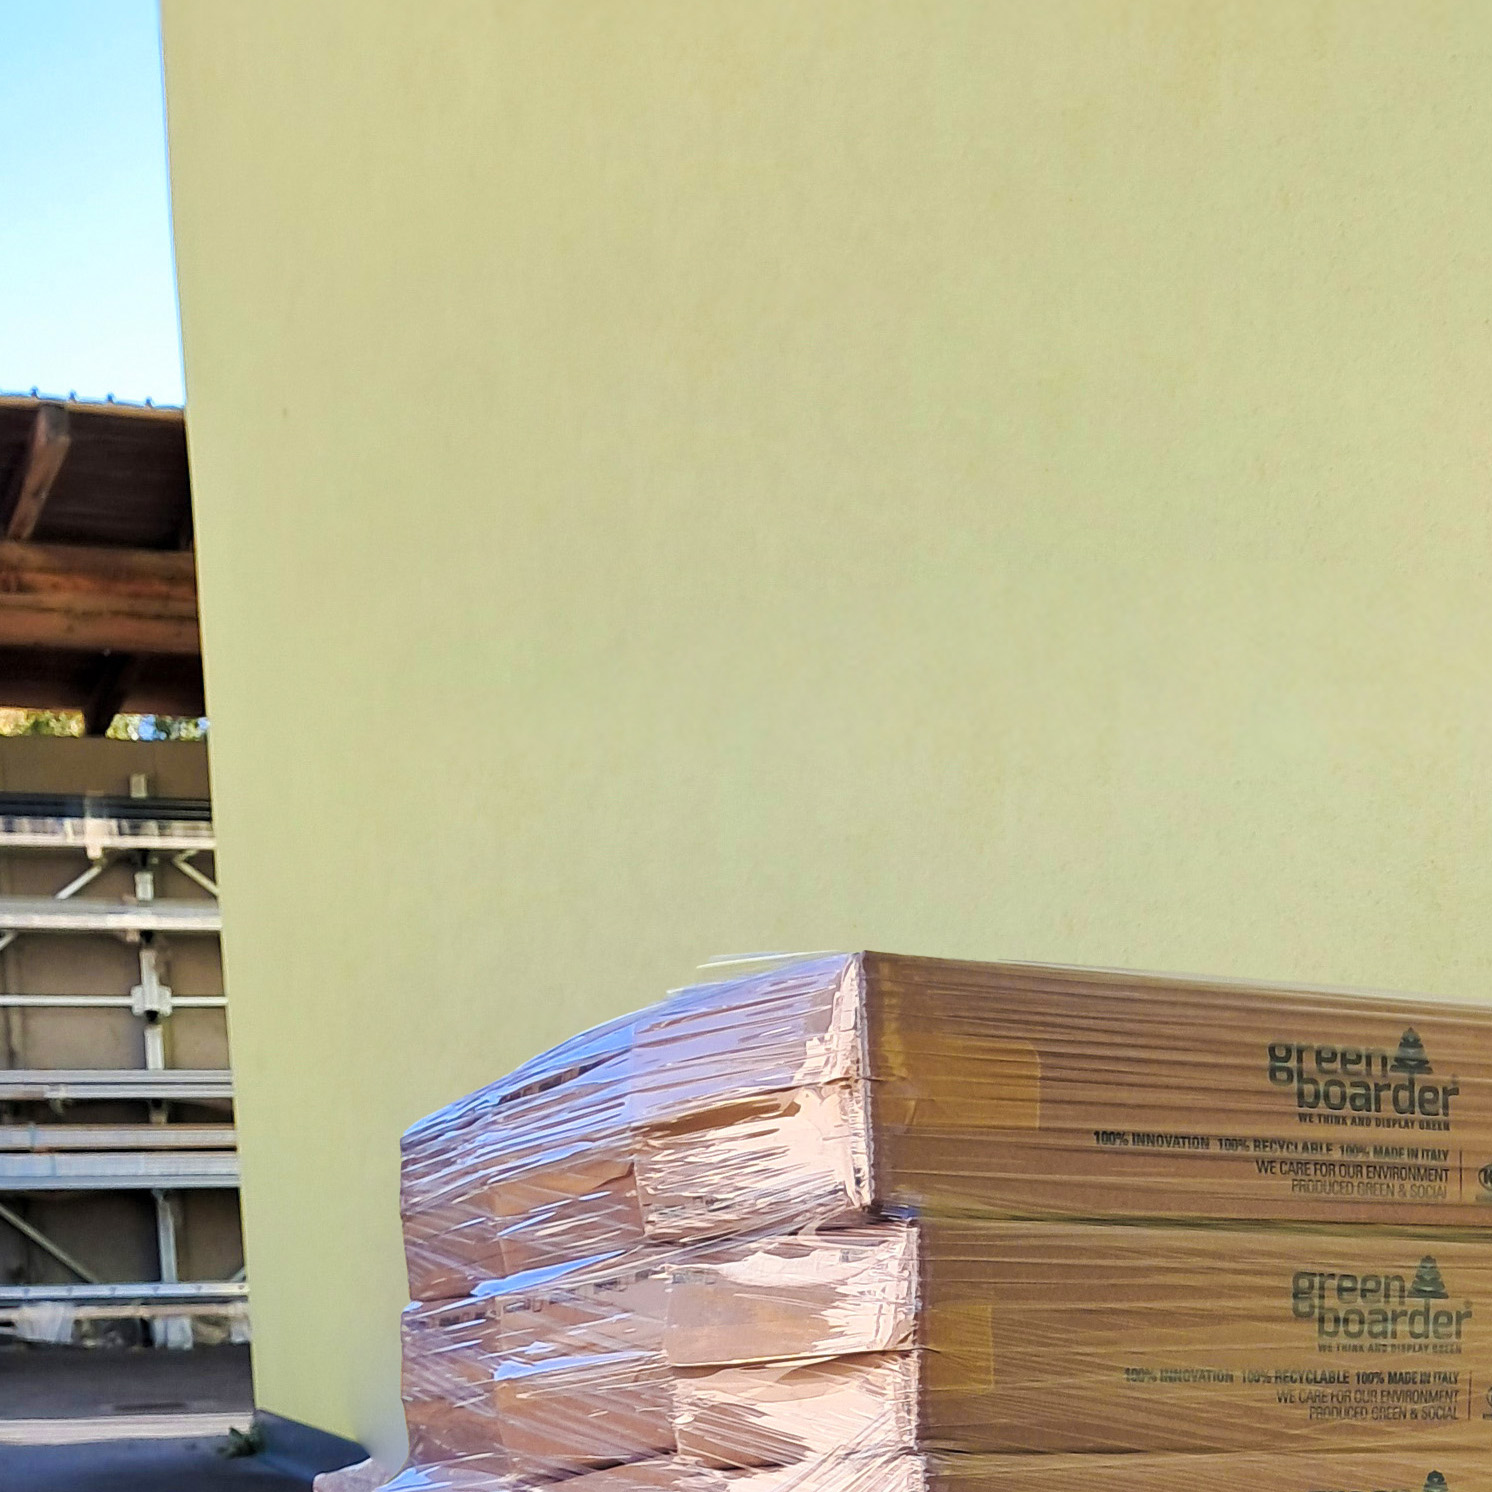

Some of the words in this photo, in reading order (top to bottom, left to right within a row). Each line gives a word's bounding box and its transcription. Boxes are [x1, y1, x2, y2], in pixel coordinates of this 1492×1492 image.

[1268, 1041, 1389, 1086] green
[1297, 1073, 1459, 1117] boarder
[1318, 1114, 1347, 1126] THINK
[1351, 1115, 1371, 1127] AND
[1375, 1117, 1415, 1130] DISPLAY
[1093, 1131, 1129, 1147] 100%
[1132, 1133, 1210, 1150] INNOVATION
[1218, 1138, 1250, 1152] 100%
[1253, 1139, 1333, 1157] RECYCLABLE
[1373, 1146, 1403, 1161] MADE
[1405, 1149, 1419, 1161] IN
[1420, 1148, 1450, 1163] ITALY
[1256, 1160, 1278, 1176] WE
[1280, 1162, 1312, 1177] CARE
[1314, 1163, 1337, 1178] FOR
[1340, 1164, 1364, 1179] OUR
[1367, 1166, 1450, 1183] ENVIRONMENT
[1292, 1179, 1354, 1197] PRODUCED
[1357, 1182, 1395, 1199] GREEN
[1398, 1184, 1407, 1198] &
[1292, 1271, 1406, 1320] green
[1318, 1298, 1473, 1340] boarder
[1275, 1371, 1350, 1385] RECYCLABLE
[1356, 1371, 1385, 1385] 100%
[1388, 1371, 1418, 1386] MADE
[1420, 1372, 1432, 1385] IN
[1434, 1372, 1459, 1386] ITALY
[1277, 1389, 1296, 1404] WE
[1299, 1390, 1327, 1404] CARE
[1330, 1390, 1352, 1404] FOR
[1354, 1390, 1378, 1404] OUR
[1381, 1390, 1459, 1405] ENVIRONMENT
[1310, 1406, 1368, 1421] PRODUCED
[1372, 1406, 1408, 1421] GREEN
[1410, 1406, 1419, 1421] &
[1422, 1406, 1459, 1421] SOCIAL
